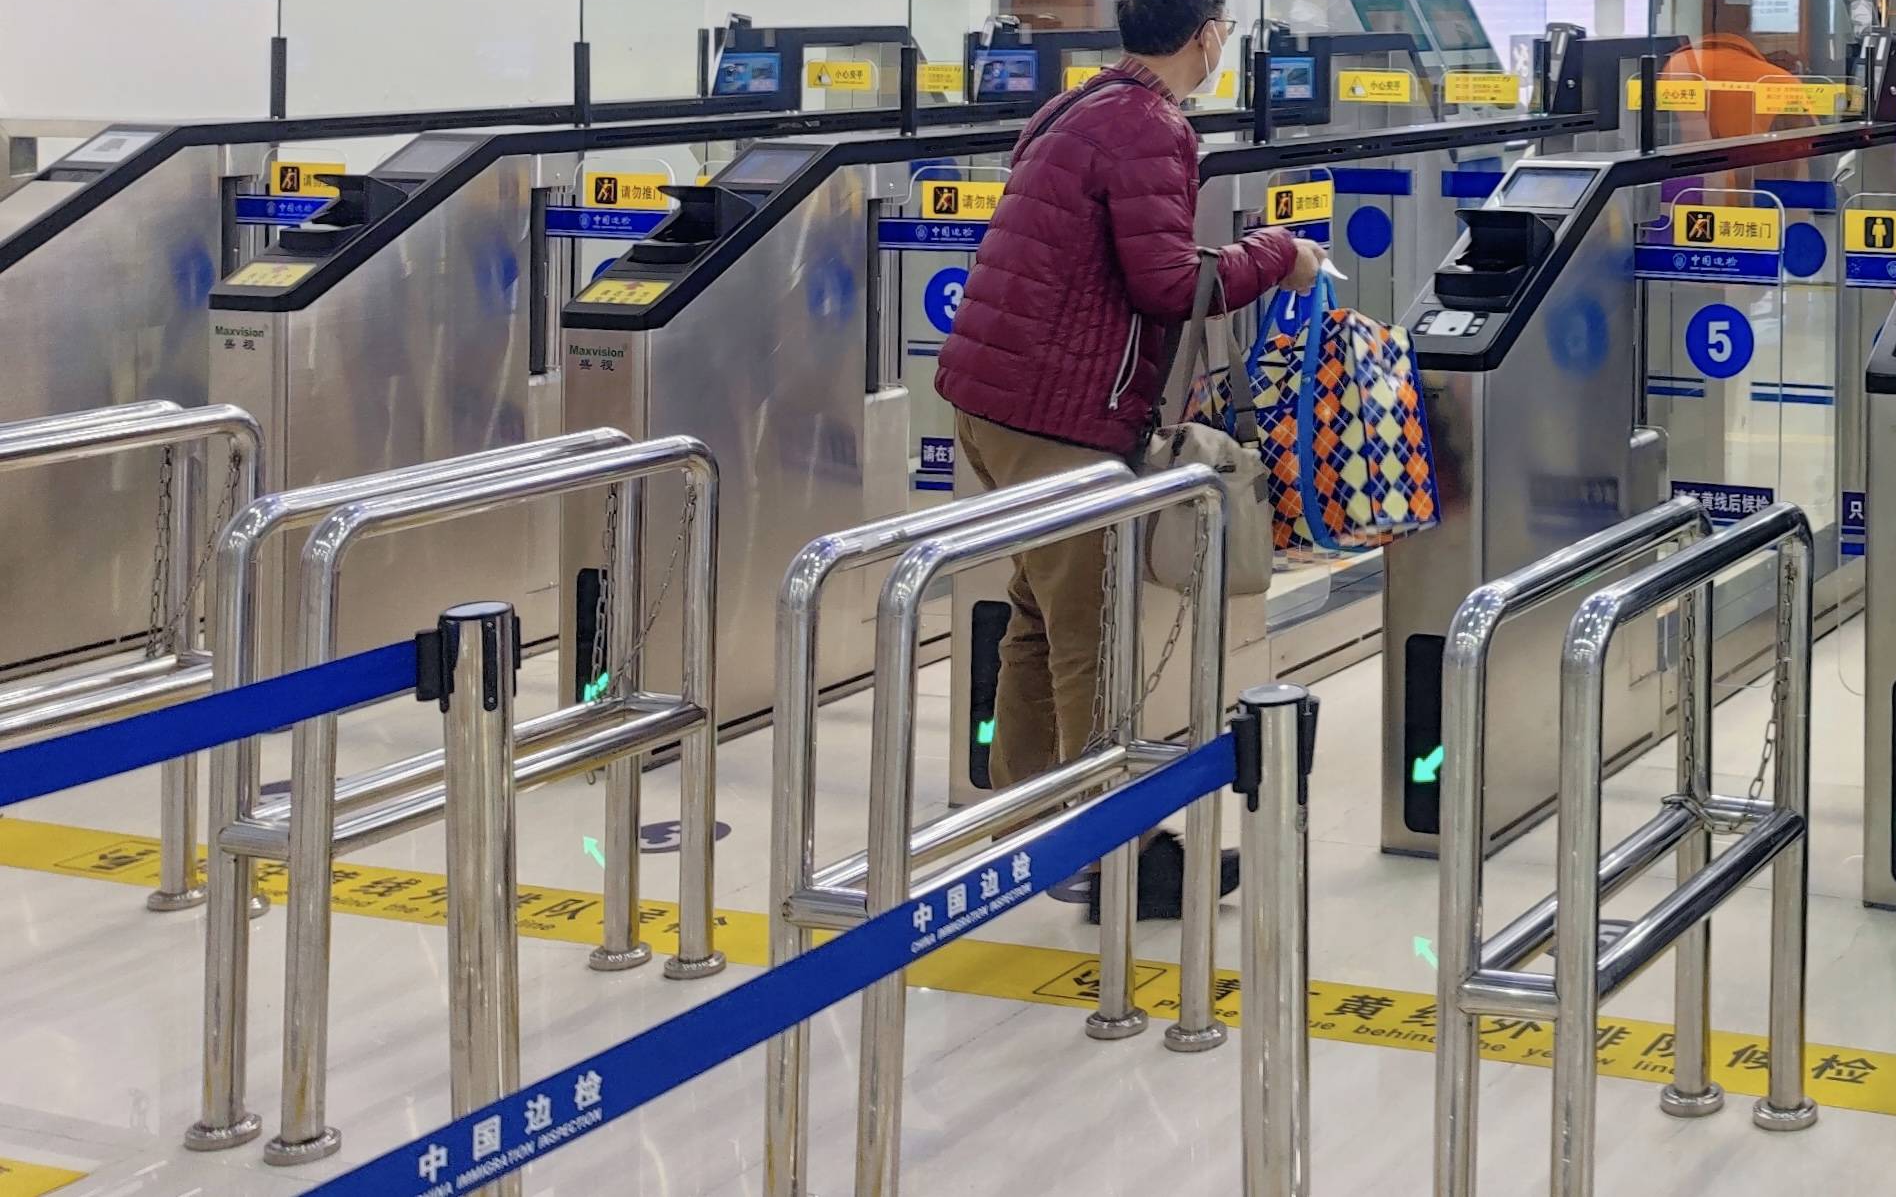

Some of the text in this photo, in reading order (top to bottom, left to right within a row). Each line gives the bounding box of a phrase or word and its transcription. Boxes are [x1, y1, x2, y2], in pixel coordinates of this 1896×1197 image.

[962, 194, 999, 210] 请勿推
[1296, 194, 1329, 211] 请勿推门
[1719, 221, 1772, 239] 请勿推门
[1690, 254, 1739, 268] 中国边检
[943, 282, 963, 319] 3
[215, 326, 265, 338] Maxvision
[569, 345, 625, 358] Maxvision
[1707, 321, 1733, 364] 5
[1848, 501, 1864, 520] 只
[913, 851, 1032, 933] 中国边检
[418, 1070, 603, 1183] 中国边检
